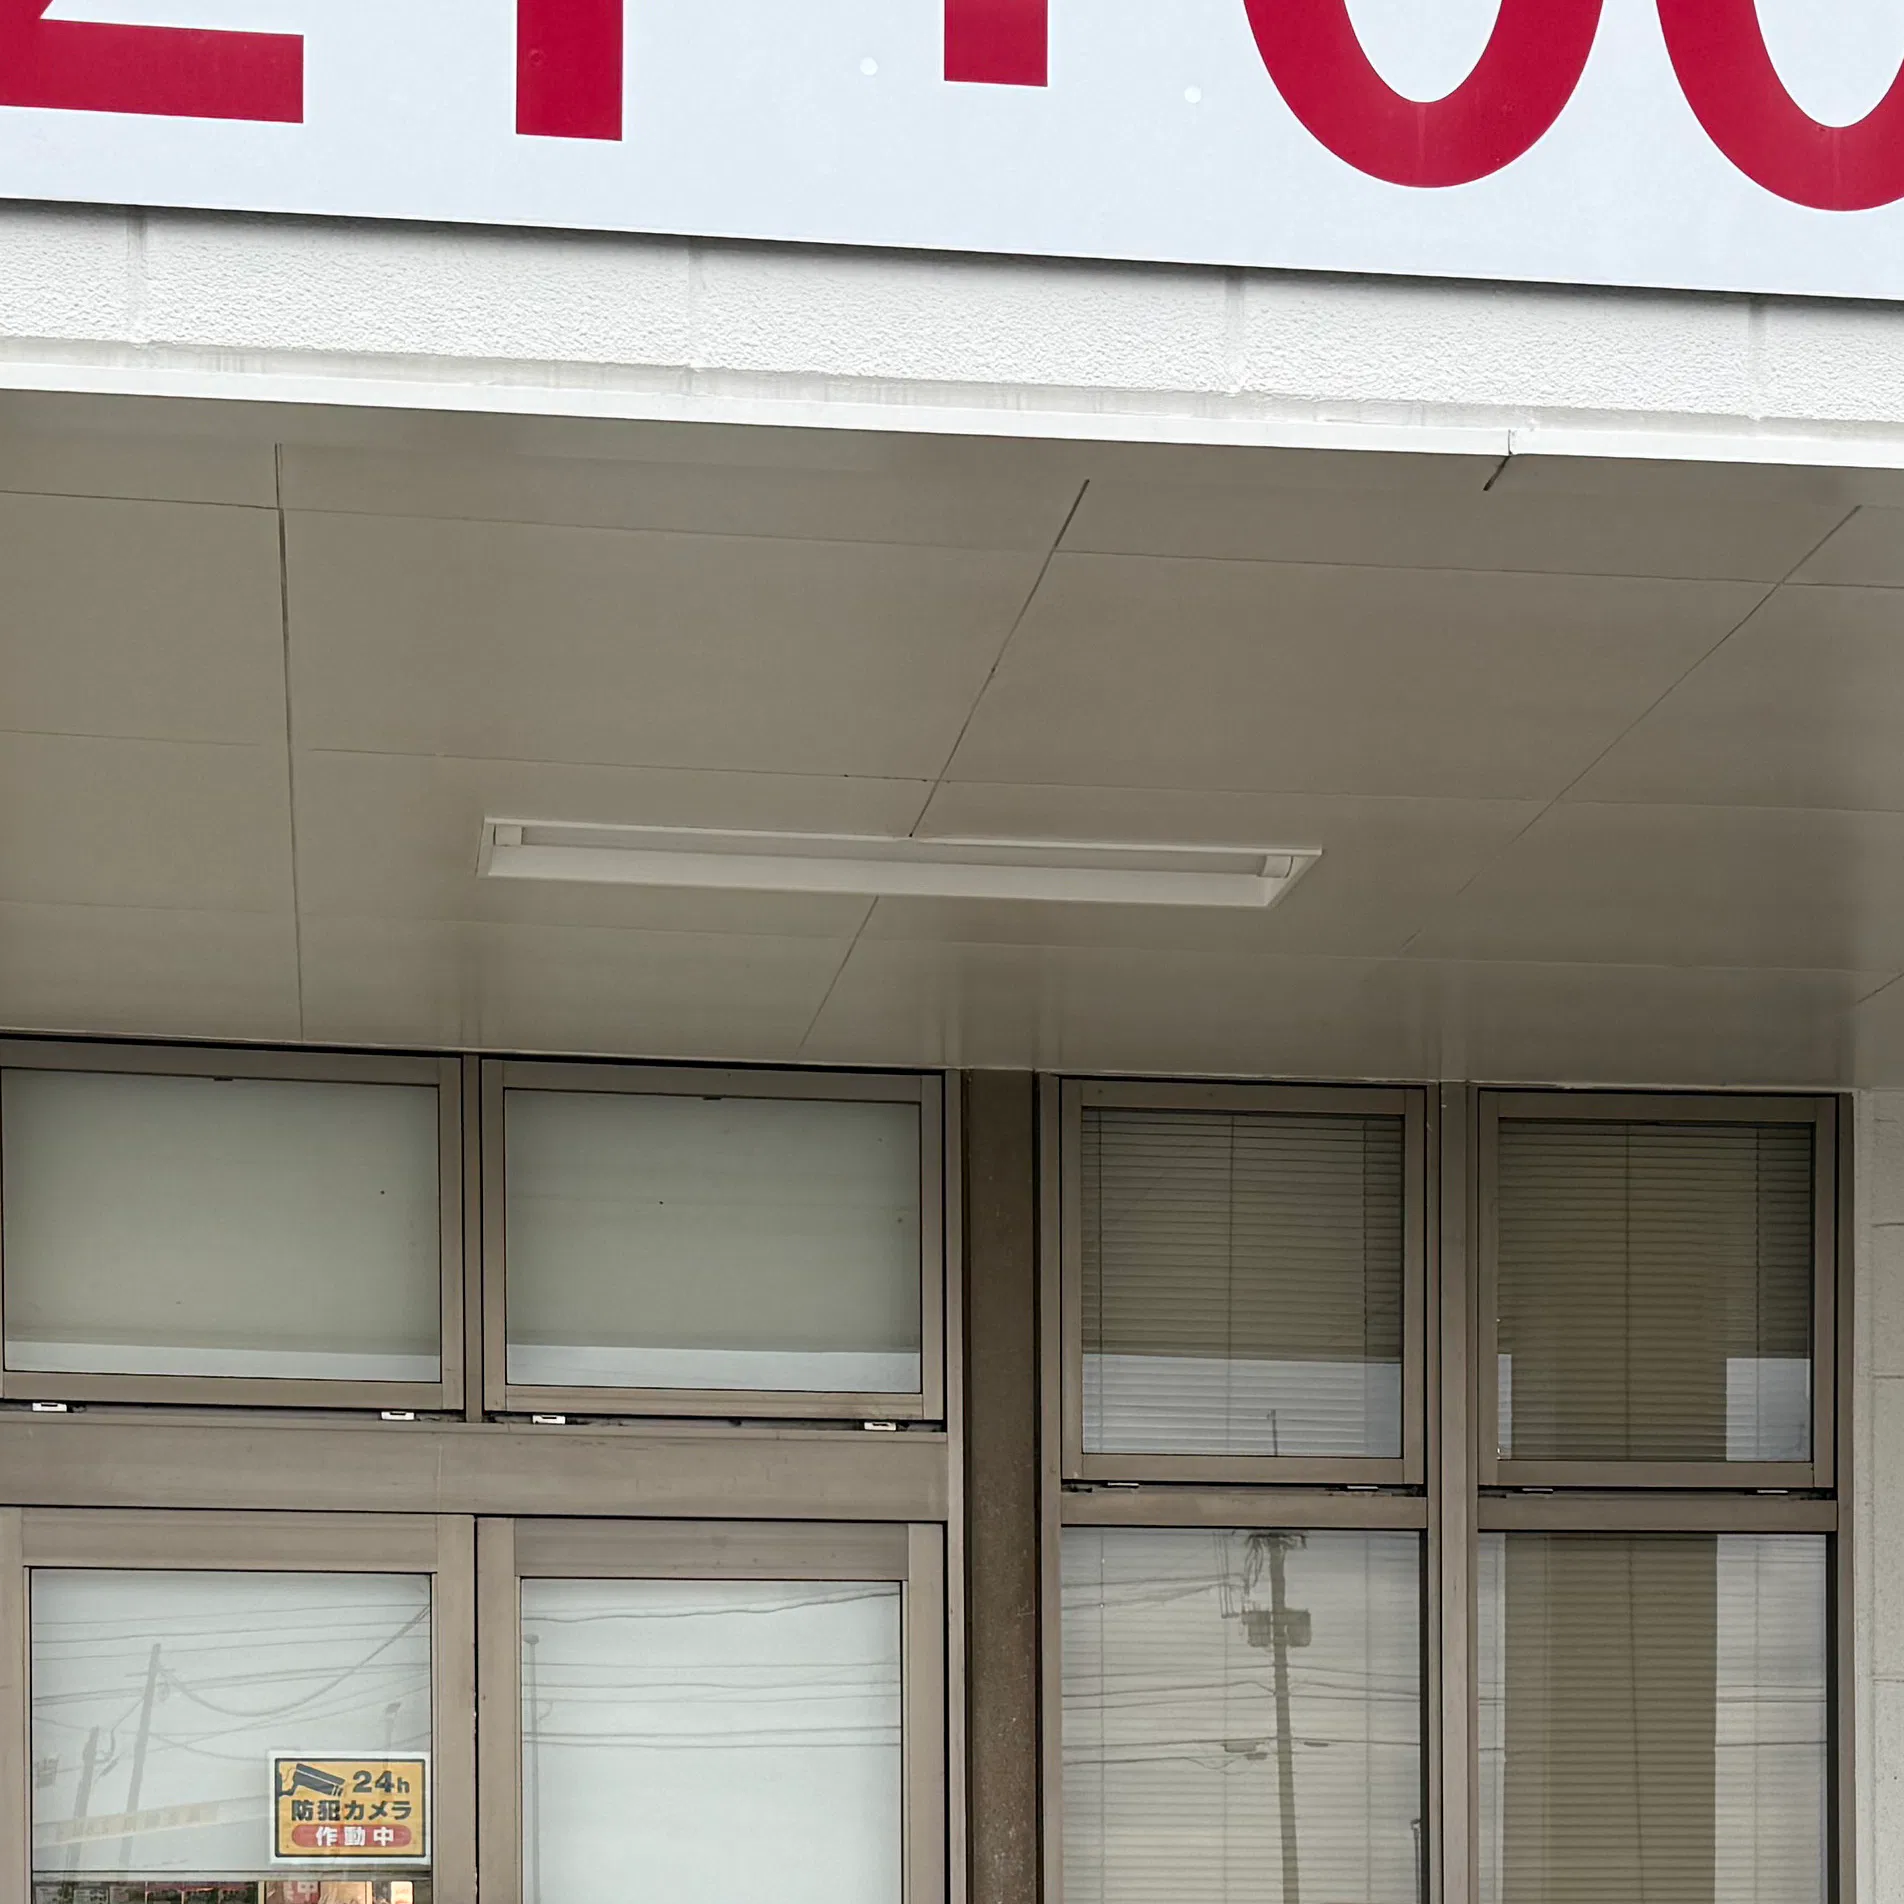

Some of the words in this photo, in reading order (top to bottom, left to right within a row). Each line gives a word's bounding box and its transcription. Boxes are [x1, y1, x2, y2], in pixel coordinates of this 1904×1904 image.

[352, 1770, 411, 1794] 24h
[291, 1799, 413, 1822] 防犯カメラ
[315, 1825, 395, 1847] 作動中
